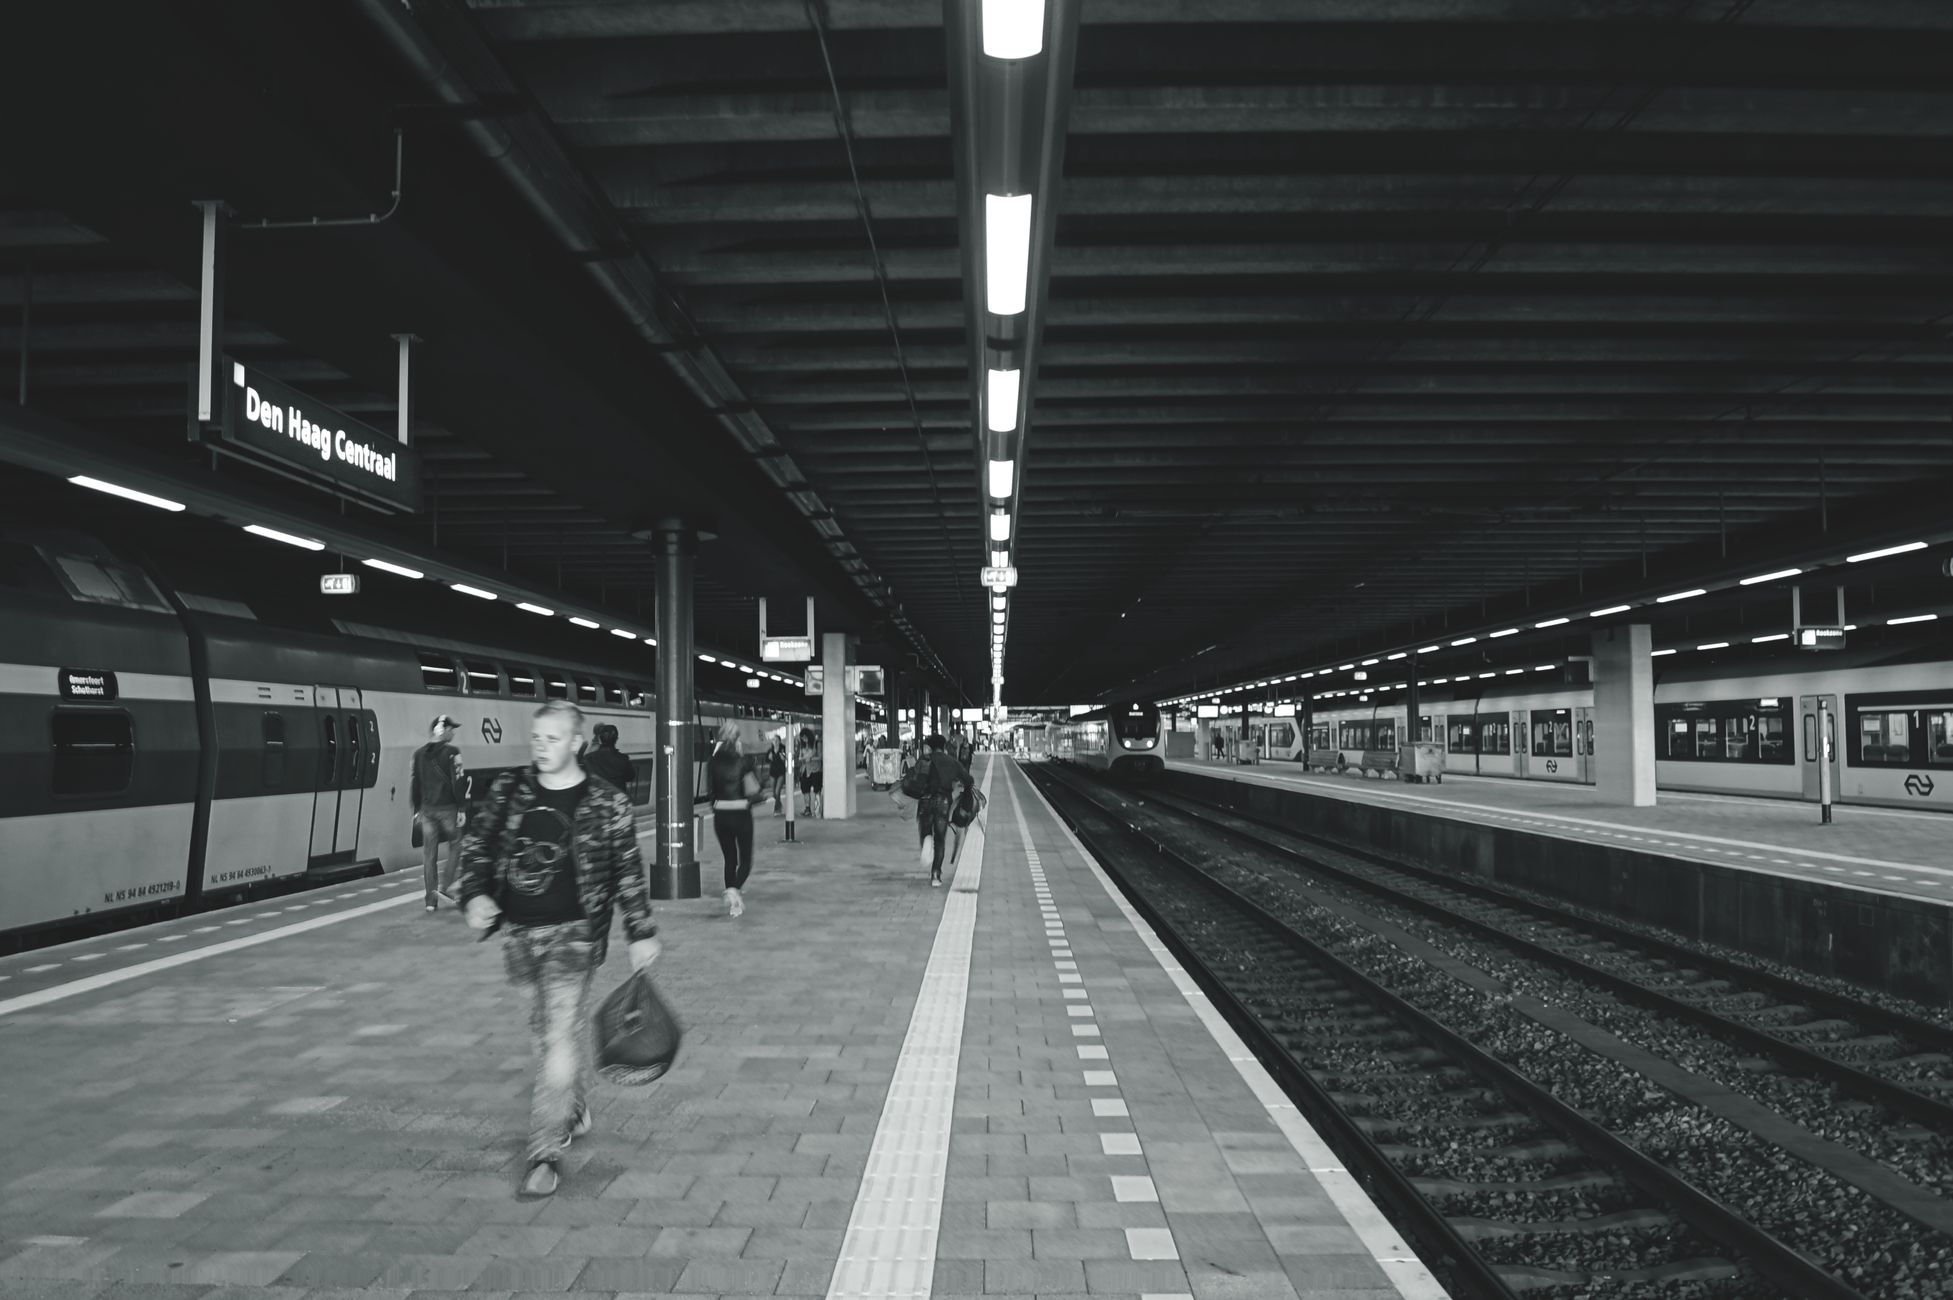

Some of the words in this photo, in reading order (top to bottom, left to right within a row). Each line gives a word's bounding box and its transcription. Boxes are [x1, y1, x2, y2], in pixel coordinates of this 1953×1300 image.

[246, 386, 284, 434] Den
[288, 406, 332, 461] Haag
[335, 430, 396, 482] Centraal
[460, 671, 469, 694] 2
[1749, 715, 1756, 731] 2
[1913, 710, 1919, 729] 1
[465, 775, 473, 799] 2
[104, 891, 114, 903] NL
[115, 889, 126, 901] NS
[127, 887, 136, 899] 94
[137, 885, 147, 897] 84
